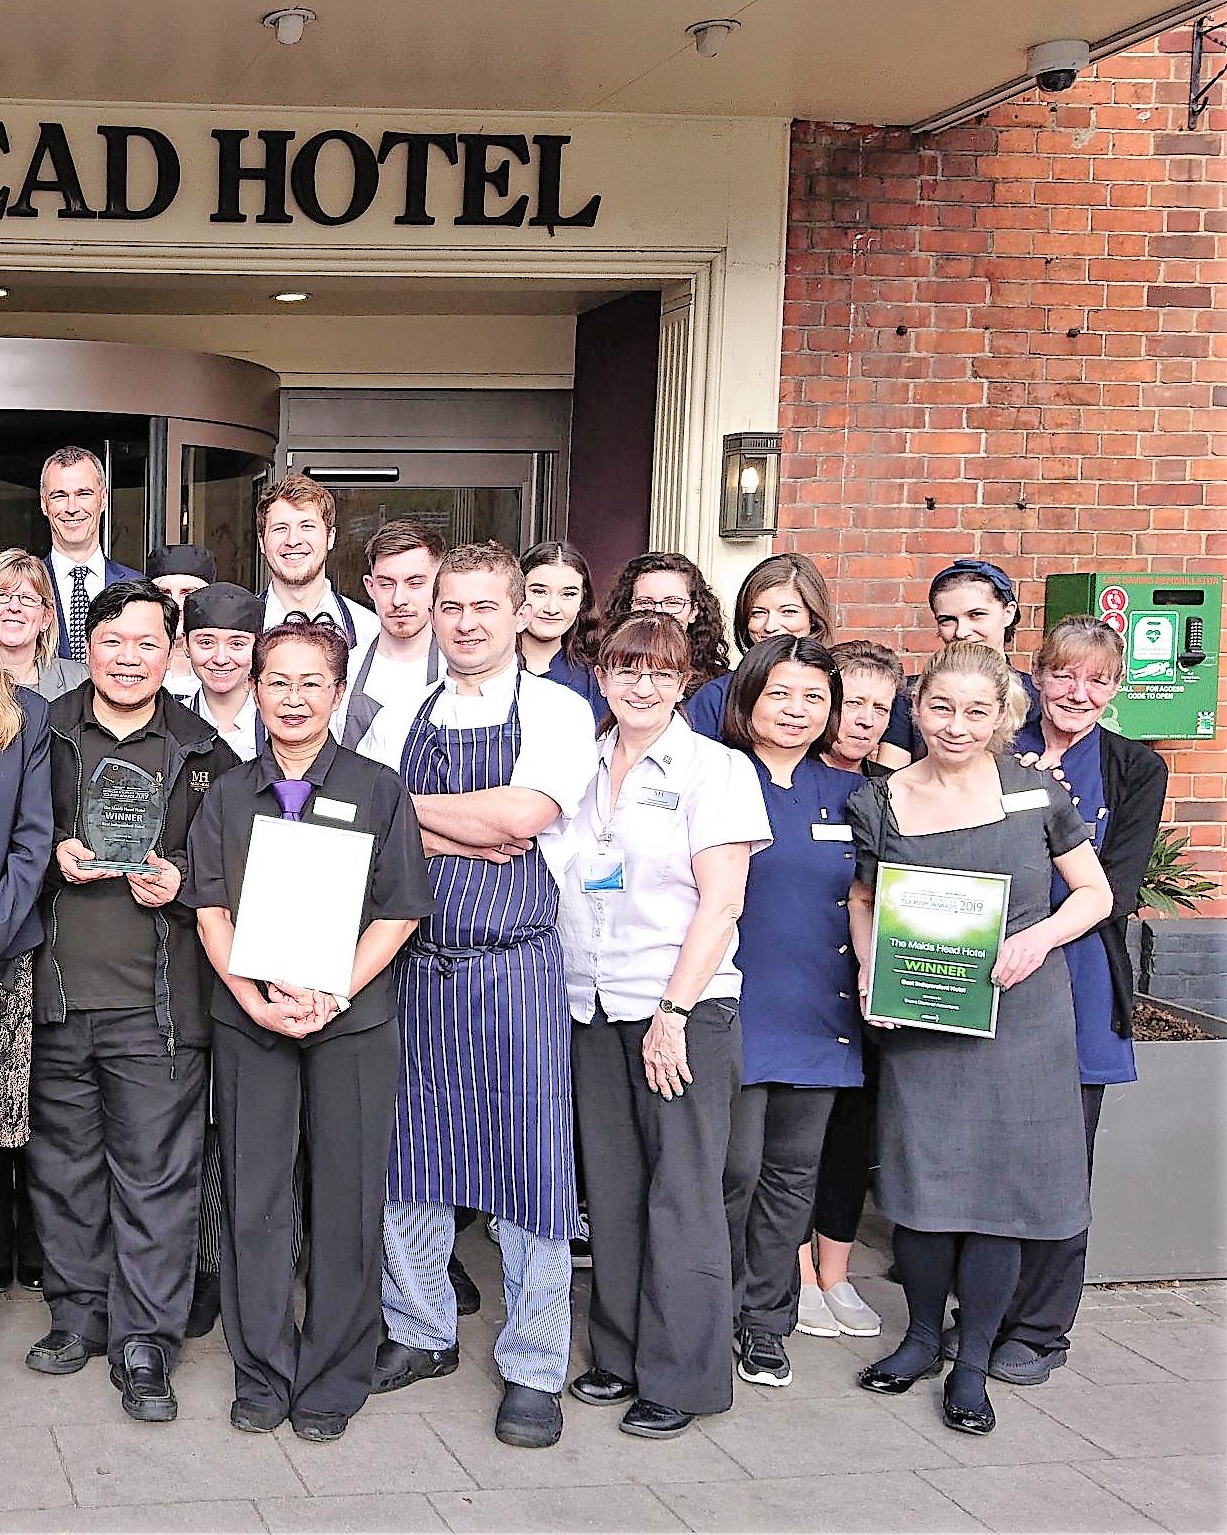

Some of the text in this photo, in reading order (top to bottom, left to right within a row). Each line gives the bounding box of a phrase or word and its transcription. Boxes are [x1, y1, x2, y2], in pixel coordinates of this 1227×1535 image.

[210, 129, 601, 228] HOTEL
[191, 771, 210, 783] MH
[105, 812, 143, 822] WINNER
[960, 901, 983, 912] 2019
[890, 937, 986, 958] The Maids Head Hotel
[904, 960, 967, 977] WINNER
